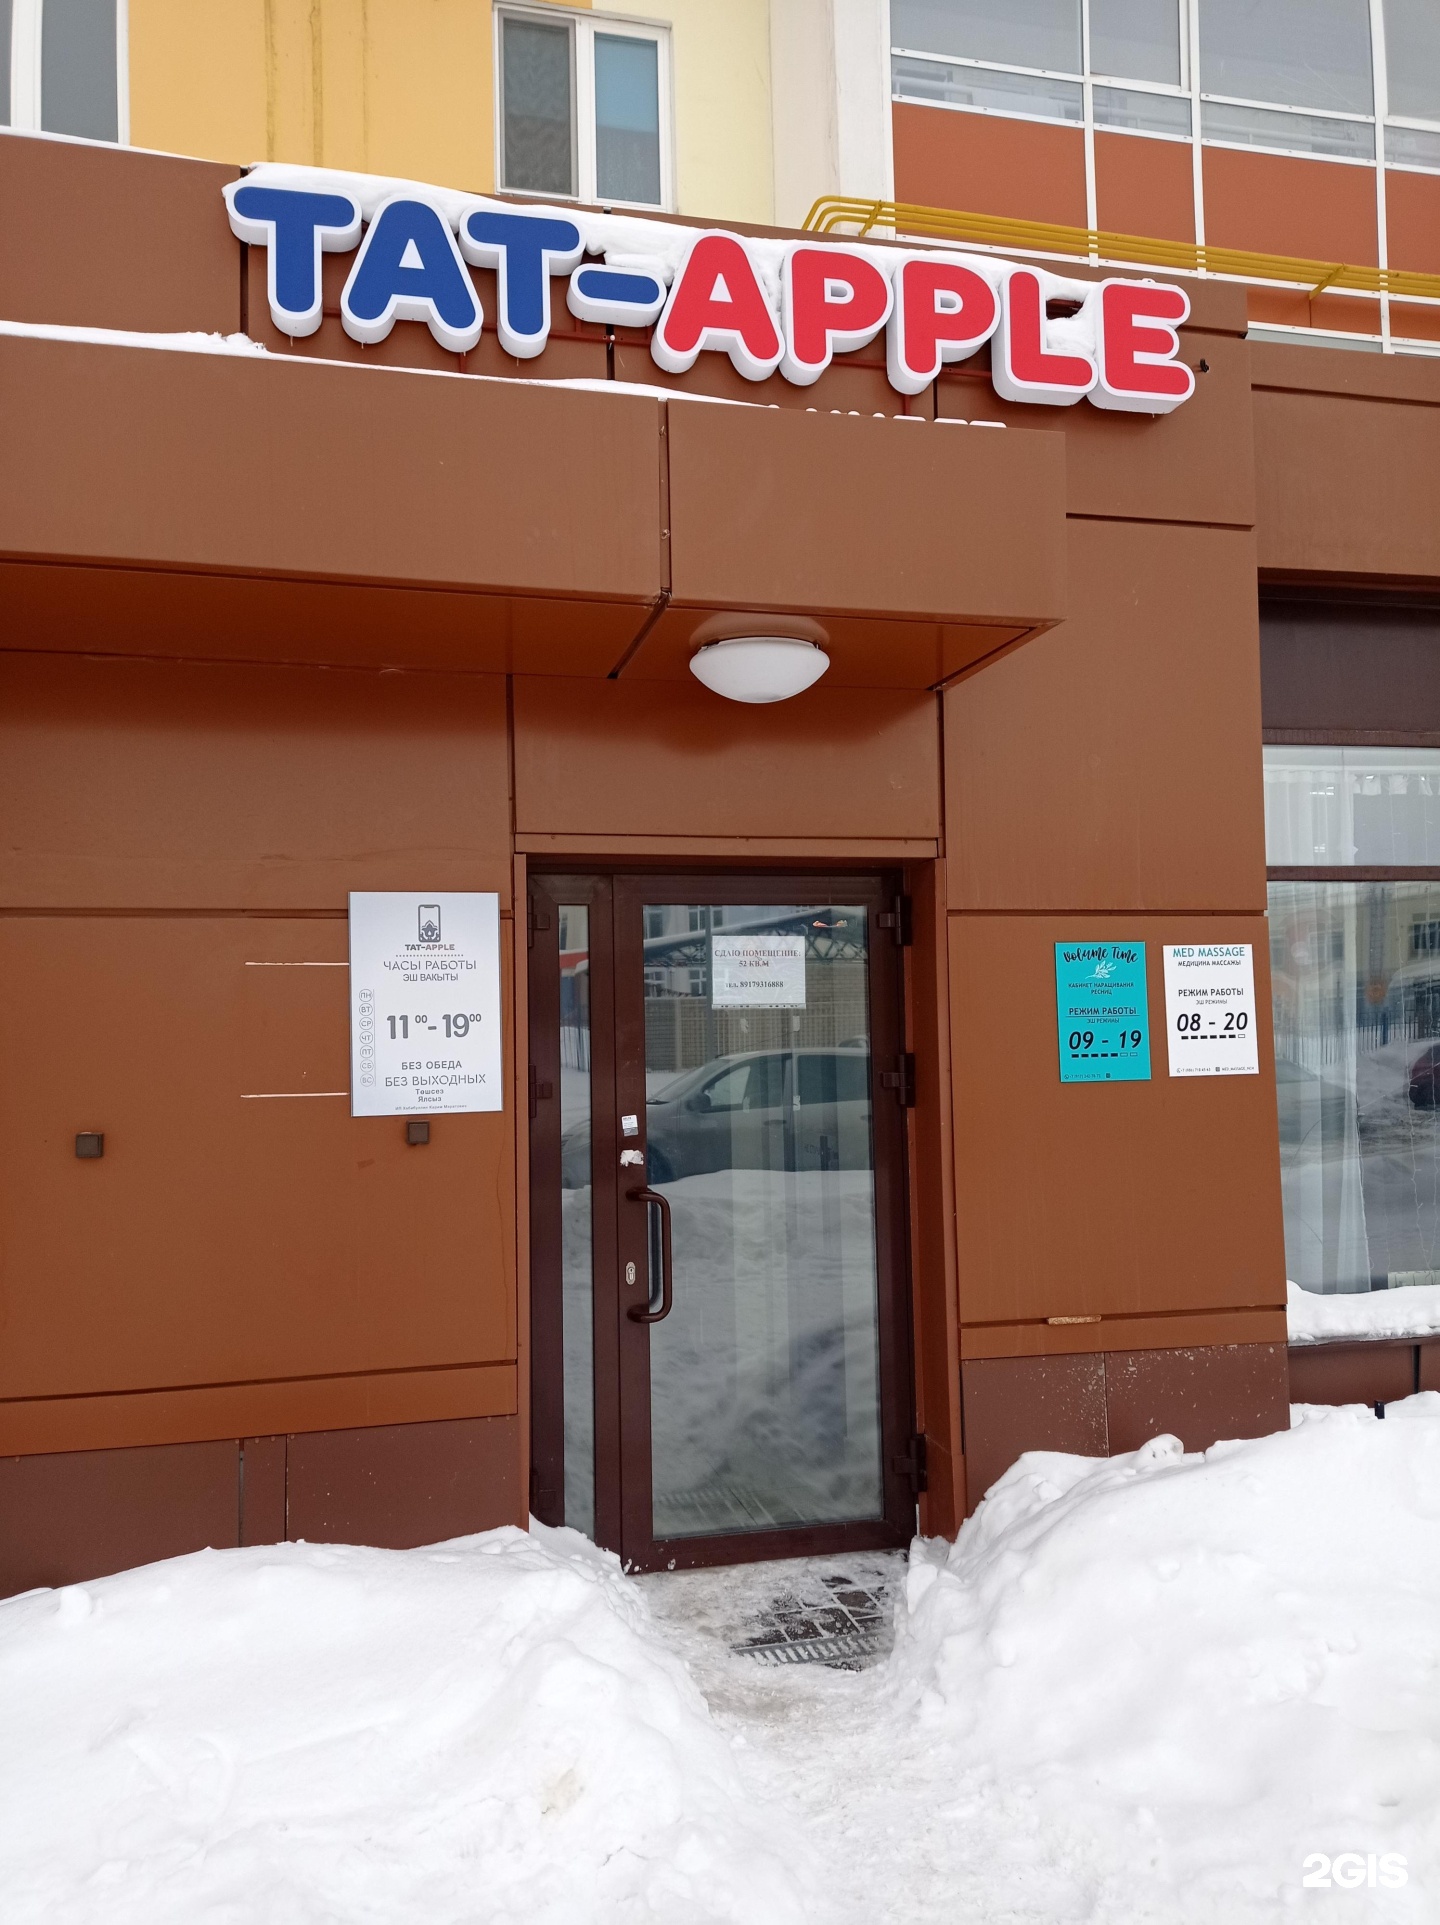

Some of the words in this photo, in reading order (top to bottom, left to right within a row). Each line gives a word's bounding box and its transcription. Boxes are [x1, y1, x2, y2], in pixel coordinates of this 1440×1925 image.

[226, 183, 1194, 410] TAT-APPLE
[714, 949, 741, 958] СДАЮ
[1063, 946, 1108, 963] Volume
[1111, 946, 1138, 963] Time
[1173, 948, 1195, 958] MED
[1198, 946, 1245, 957] MASSAGE
[383, 960, 421, 971] ЧАСЫ
[425, 960, 477, 970] РАБОТЫ
[402, 973, 418, 982] ЭШ
[420, 973, 459, 982] ВАКЫТЫ
[1093, 981, 1134, 989] НАРАЩИВАНИЯ
[1178, 988, 1208, 997] РЕЖИМ
[1210, 988, 1244, 996] РАБОТЫ
[1069, 1007, 1100, 1016] РЕЖИМ
[1102, 1006, 1137, 1015] РАБОТЫ
[386, 1014, 409, 1040] 11
[1176, 1013, 1201, 1032] 08
[1223, 1012, 1248, 1031] 20
[1068, 1031, 1094, 1050] 09
[1119, 1030, 1142, 1049] 19
[361, 1062, 372, 1070] СБ
[401, 1061, 422, 1071] БЕЗ
[425, 1060, 463, 1070] ОБЕДА
[362, 1076, 372, 1084] ВС
[385, 1076, 408, 1087] БЕЗ
[412, 1073, 486, 1087] ВЫХОДНЫХ
